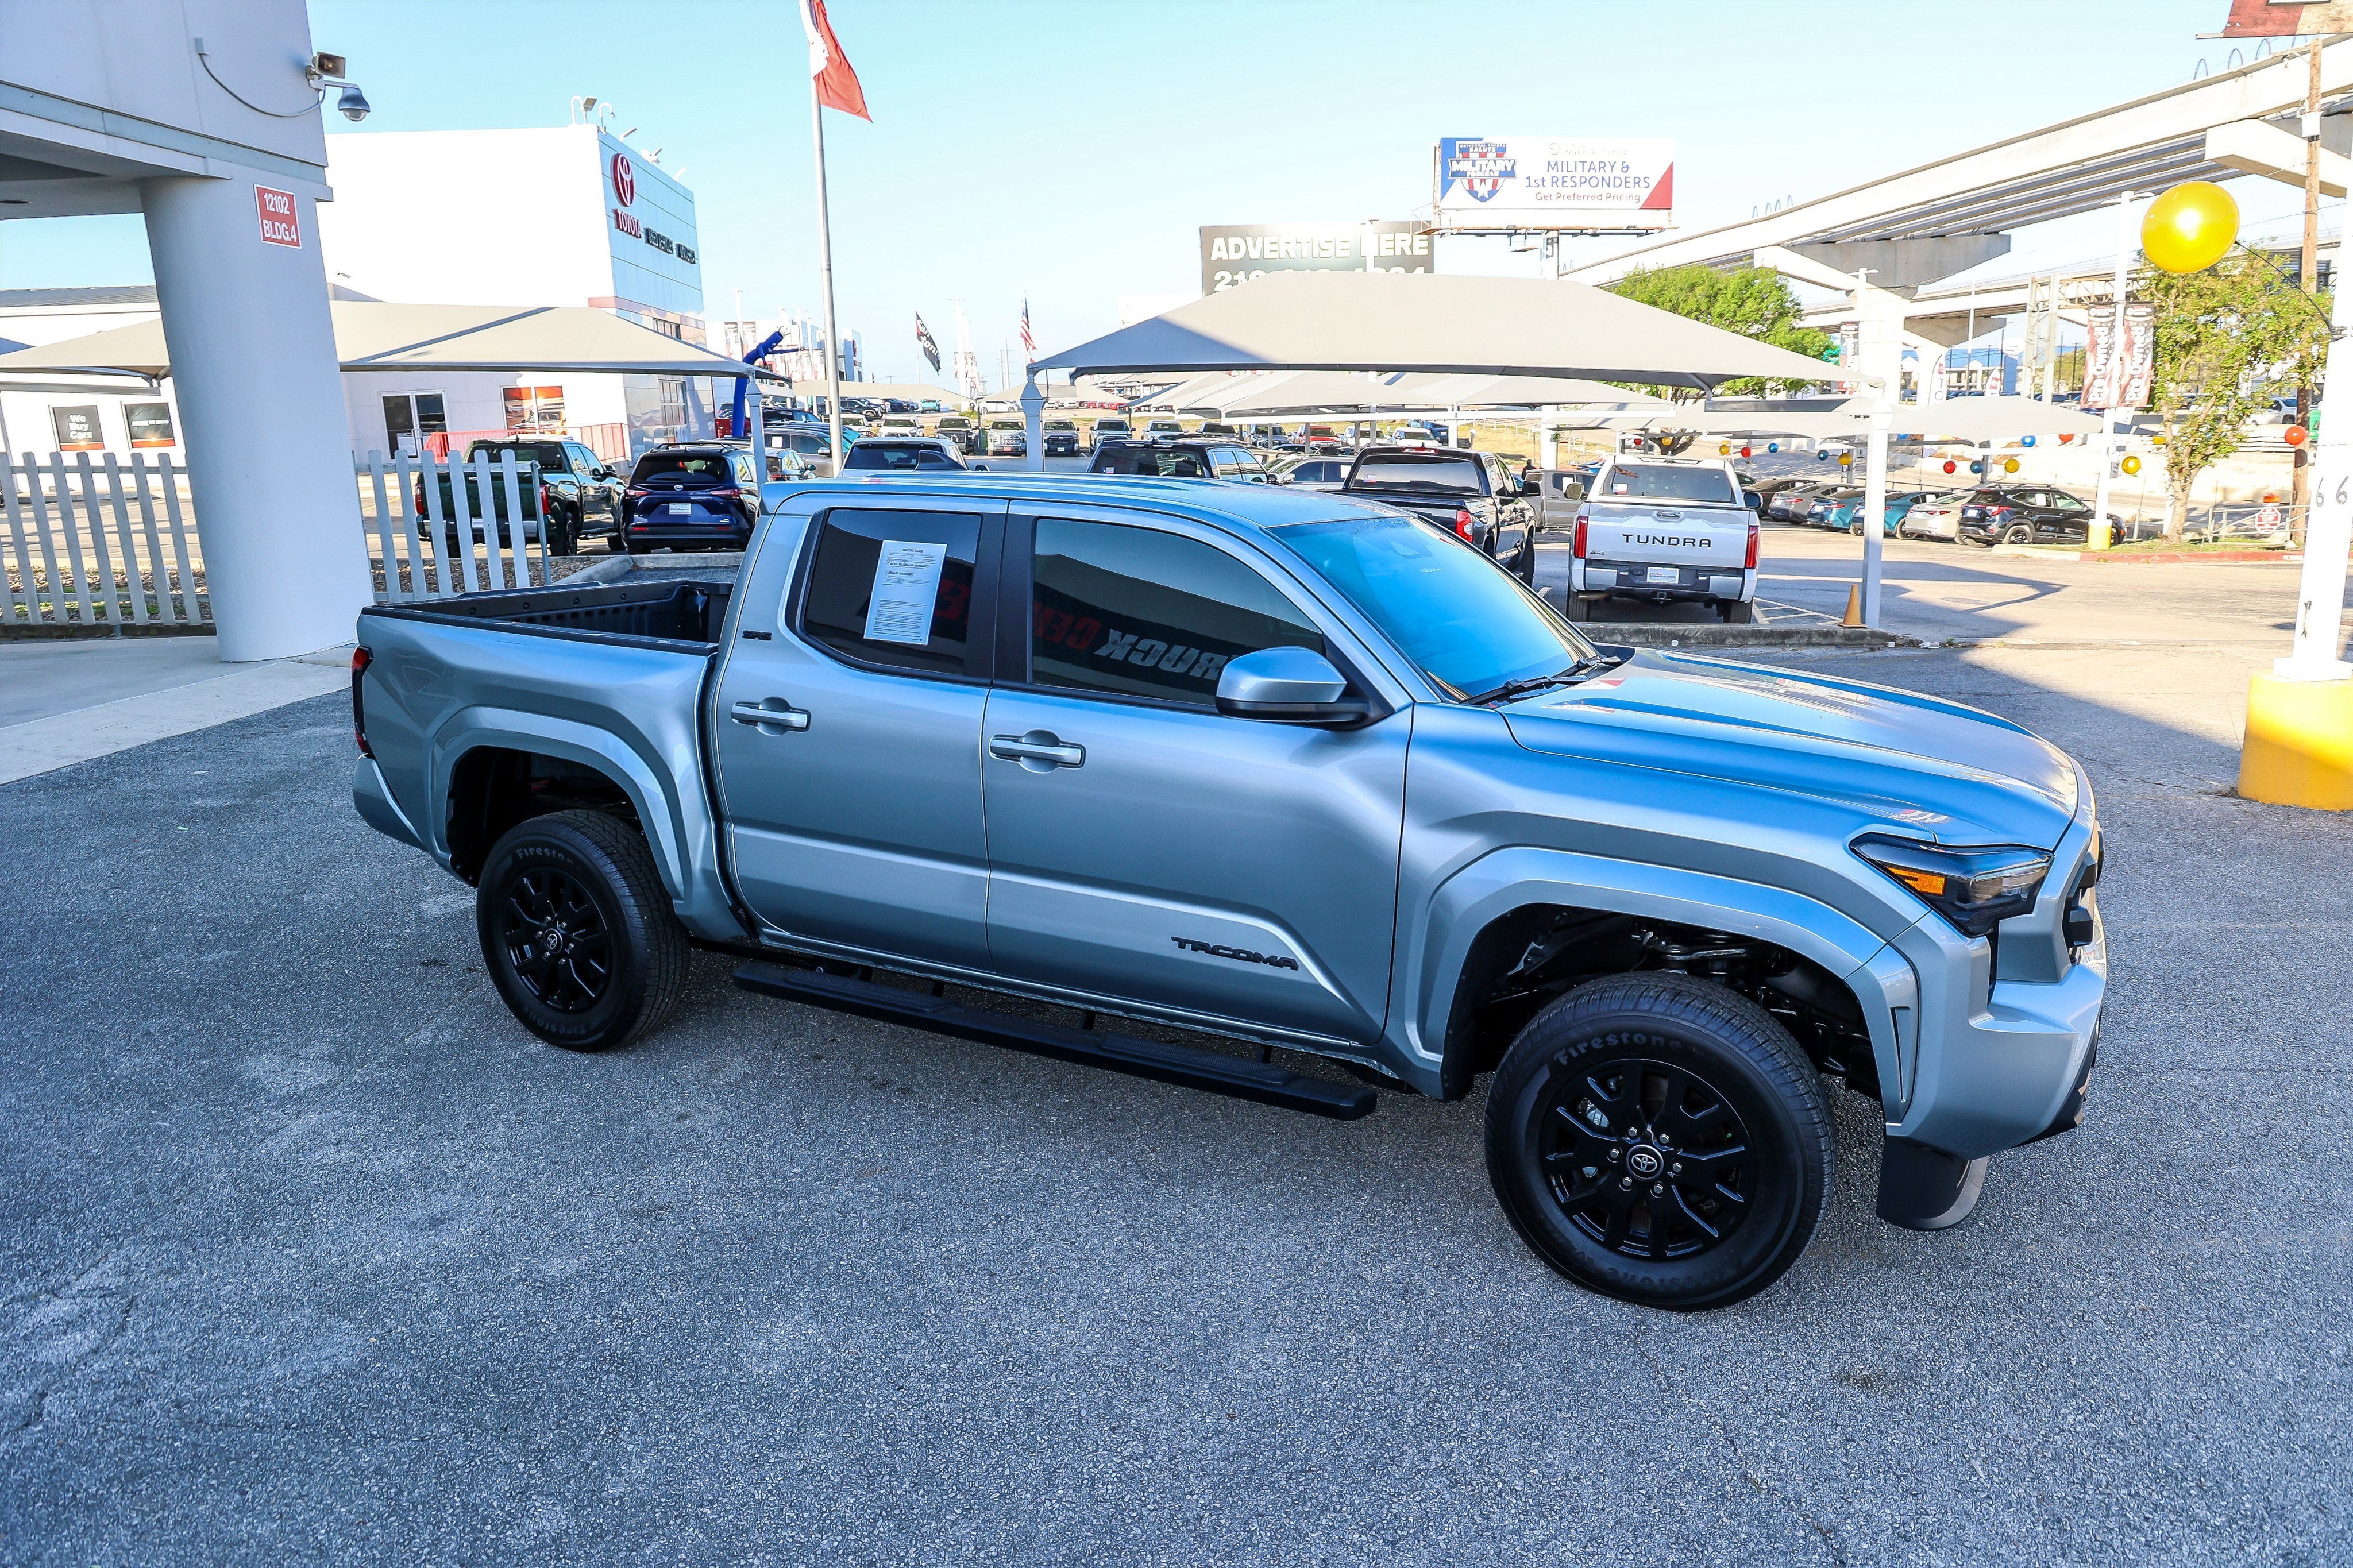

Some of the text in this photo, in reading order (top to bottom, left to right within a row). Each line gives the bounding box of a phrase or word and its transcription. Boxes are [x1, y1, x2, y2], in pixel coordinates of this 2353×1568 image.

[1451, 160, 1515, 172] MILITARY
[1546, 161, 1630, 173] MILITARY &
[1526, 176, 1650, 188] 1st RESPONDERS
[264, 192, 290, 215] 12102
[1534, 192, 1641, 203] Get Preferred Pricing
[613, 209, 642, 238] TOYOTA
[1210, 234, 1351, 260] ADVERTISE
[68, 414, 87, 423] We
[69, 423, 89, 431] Buy
[70, 431, 93, 439] Cars
[1621, 533, 1712, 549] TUNDRA
[742, 629, 773, 641] SR5
[1171, 936, 1299, 971] TACOMA
[1553, 1032, 1682, 1066] Firestone
